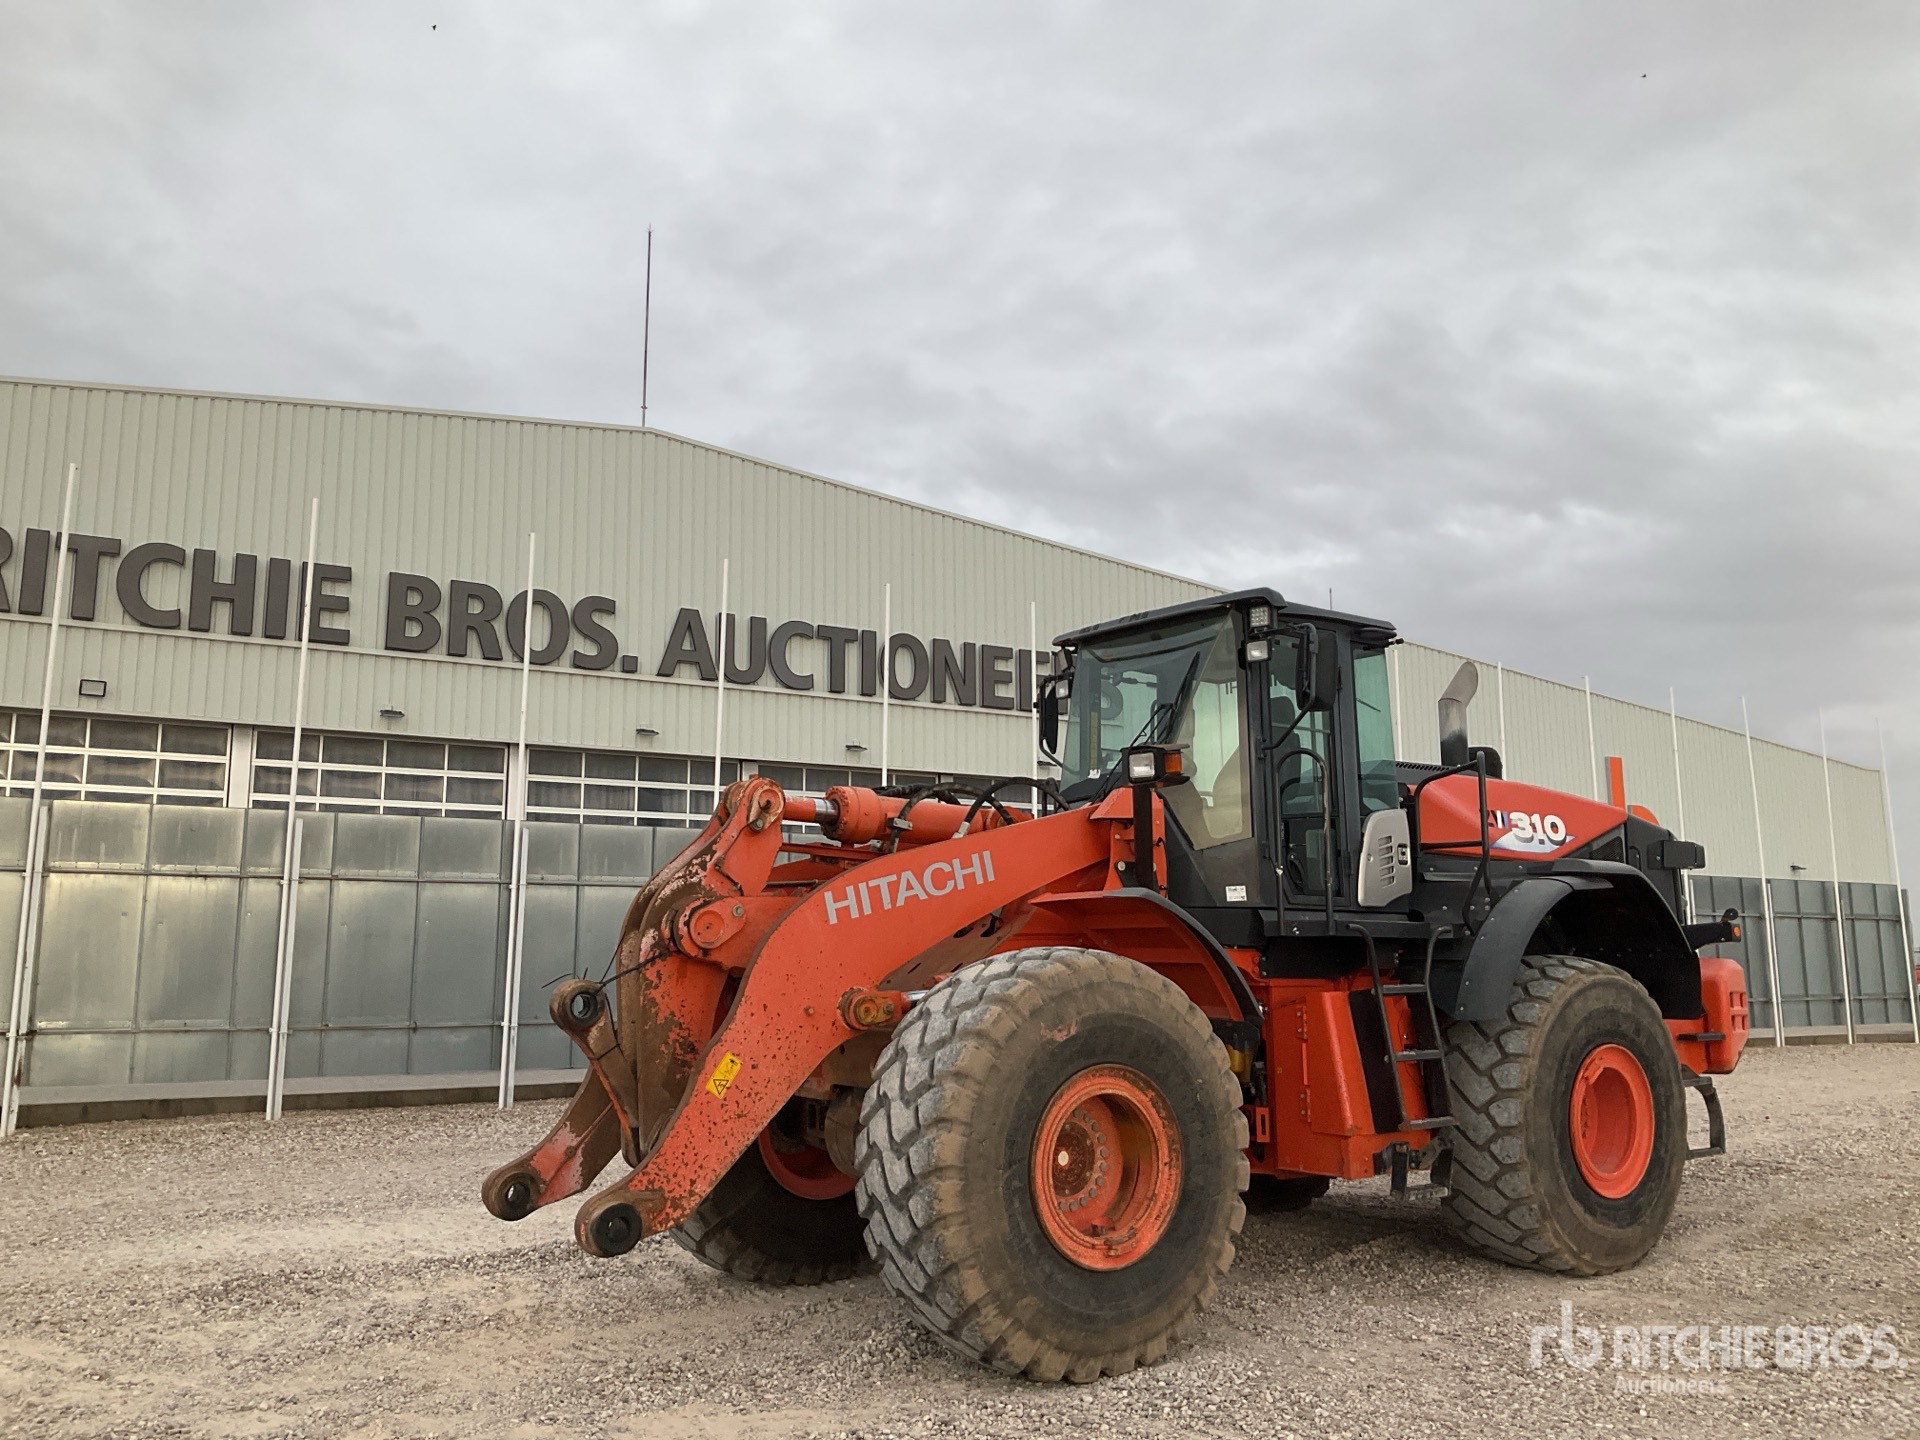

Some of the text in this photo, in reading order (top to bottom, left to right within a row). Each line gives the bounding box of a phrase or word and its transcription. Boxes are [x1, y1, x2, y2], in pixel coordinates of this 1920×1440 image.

[0, 527, 352, 645] ITCHIE
[385, 571, 638, 673] BROS.
[823, 850, 995, 925] HITACHI
